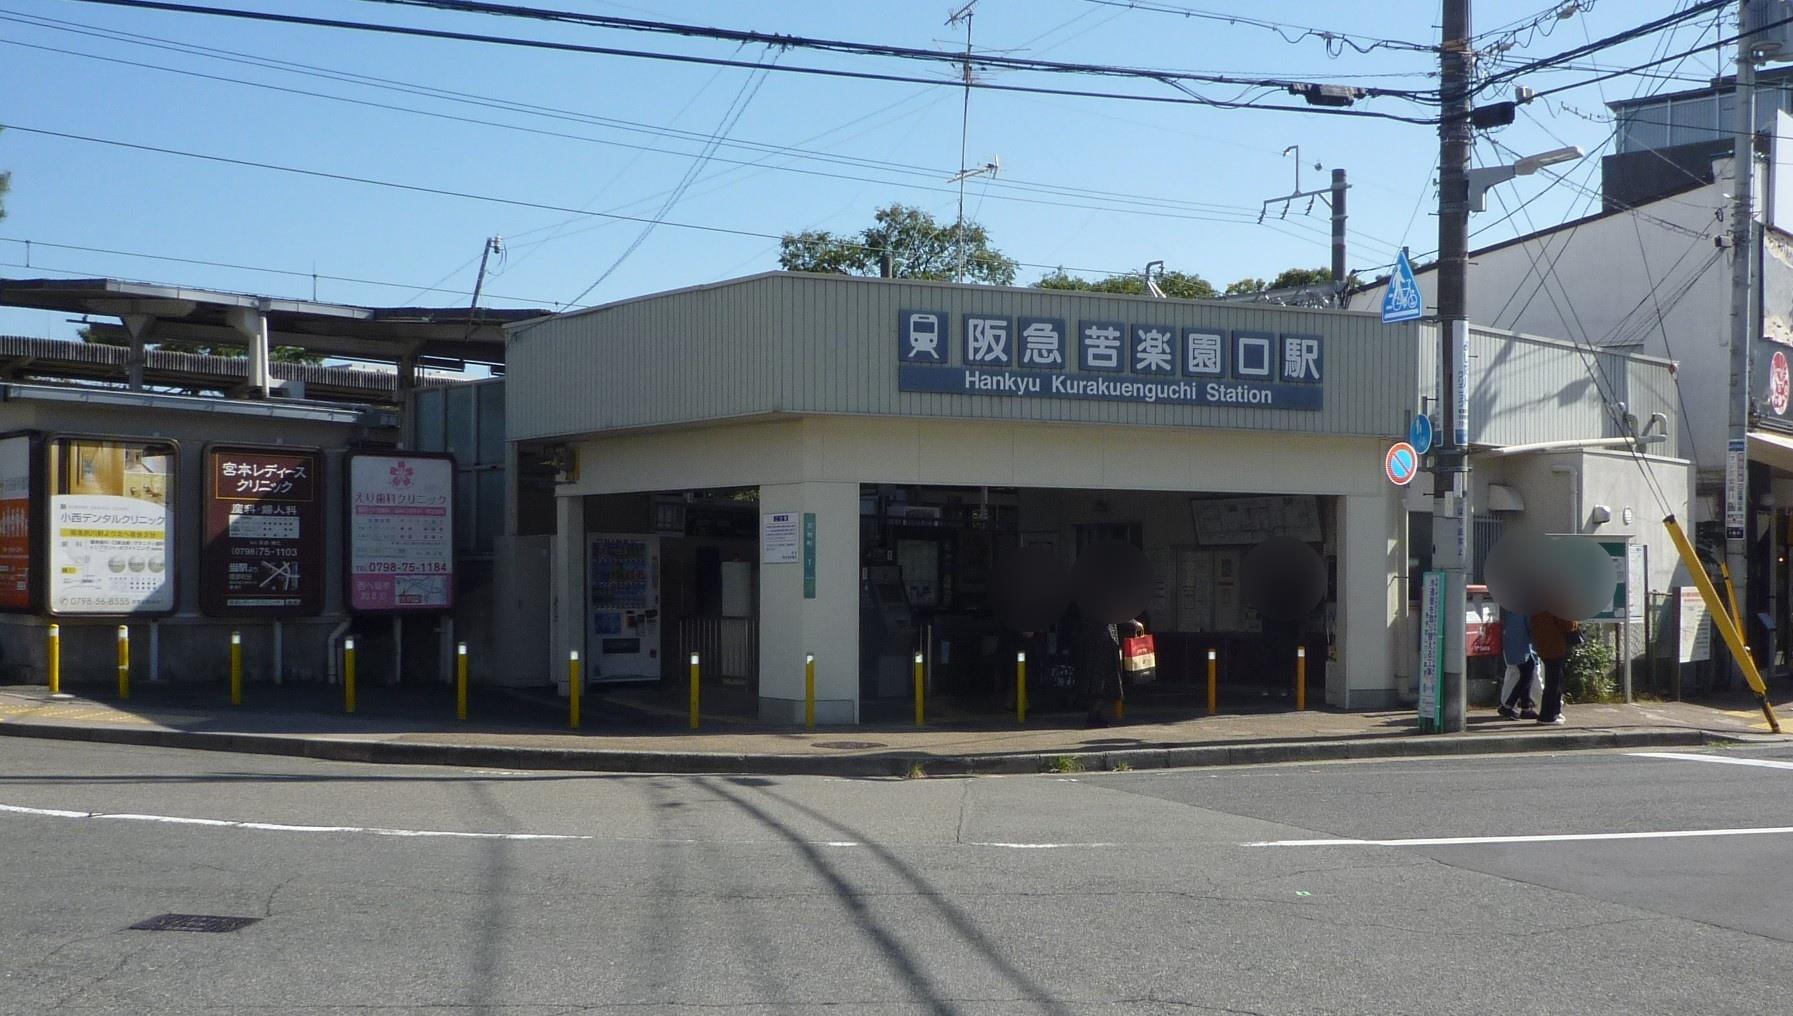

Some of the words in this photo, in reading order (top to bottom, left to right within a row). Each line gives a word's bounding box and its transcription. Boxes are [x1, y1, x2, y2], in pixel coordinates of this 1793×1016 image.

[967, 318, 1320, 380] 阪急苦楽園口駅
[964, 370, 1040, 396] Hankyu
[1052, 374, 1197, 402] Kurakuenguchi
[1206, 382, 1272, 404] Station
[221, 462, 308, 479] 宮本レディース
[236, 478, 294, 494] クリニック
[59, 512, 166, 526] 小西デンタルクリニック
[368, 561, 447, 573] 0798-75-1184
